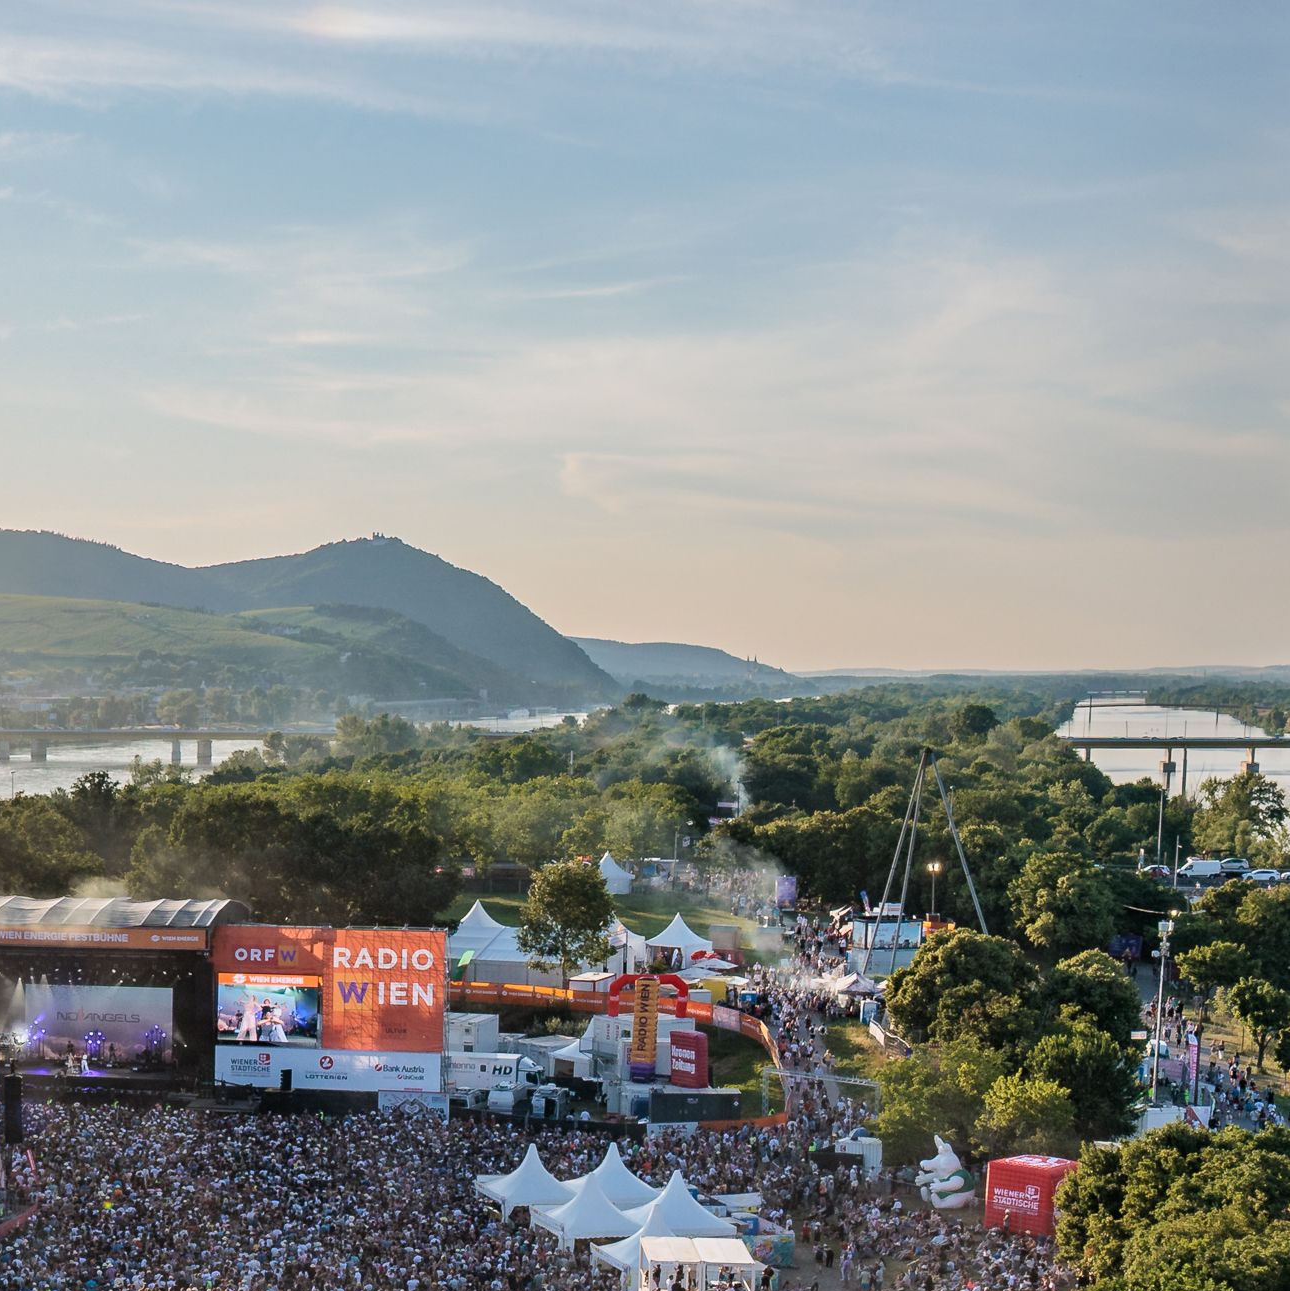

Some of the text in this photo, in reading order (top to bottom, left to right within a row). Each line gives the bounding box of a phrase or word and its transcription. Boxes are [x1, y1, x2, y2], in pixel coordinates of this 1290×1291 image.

[28, 931, 68, 941] ENERGIE
[70, 932, 129, 943] FESTBÜHNE
[234, 947, 297, 962] ORF W
[333, 947, 434, 971] RADIO
[248, 975, 305, 985] WIEN ENERGIE
[337, 980, 434, 1006] WIEN
[639, 983, 651, 1014] WIEN
[56, 1011, 141, 1023] NO ANGELS
[637, 1016, 649, 1052] RADIO
[671, 1045, 696, 1060] Kronen
[231, 1058, 258, 1066] WIENER
[671, 1058, 696, 1075] Zeitung
[383, 1064, 425, 1074] Bank Austria
[491, 1065, 513, 1076] HD
[993, 1187, 1027, 1199] WIENER
